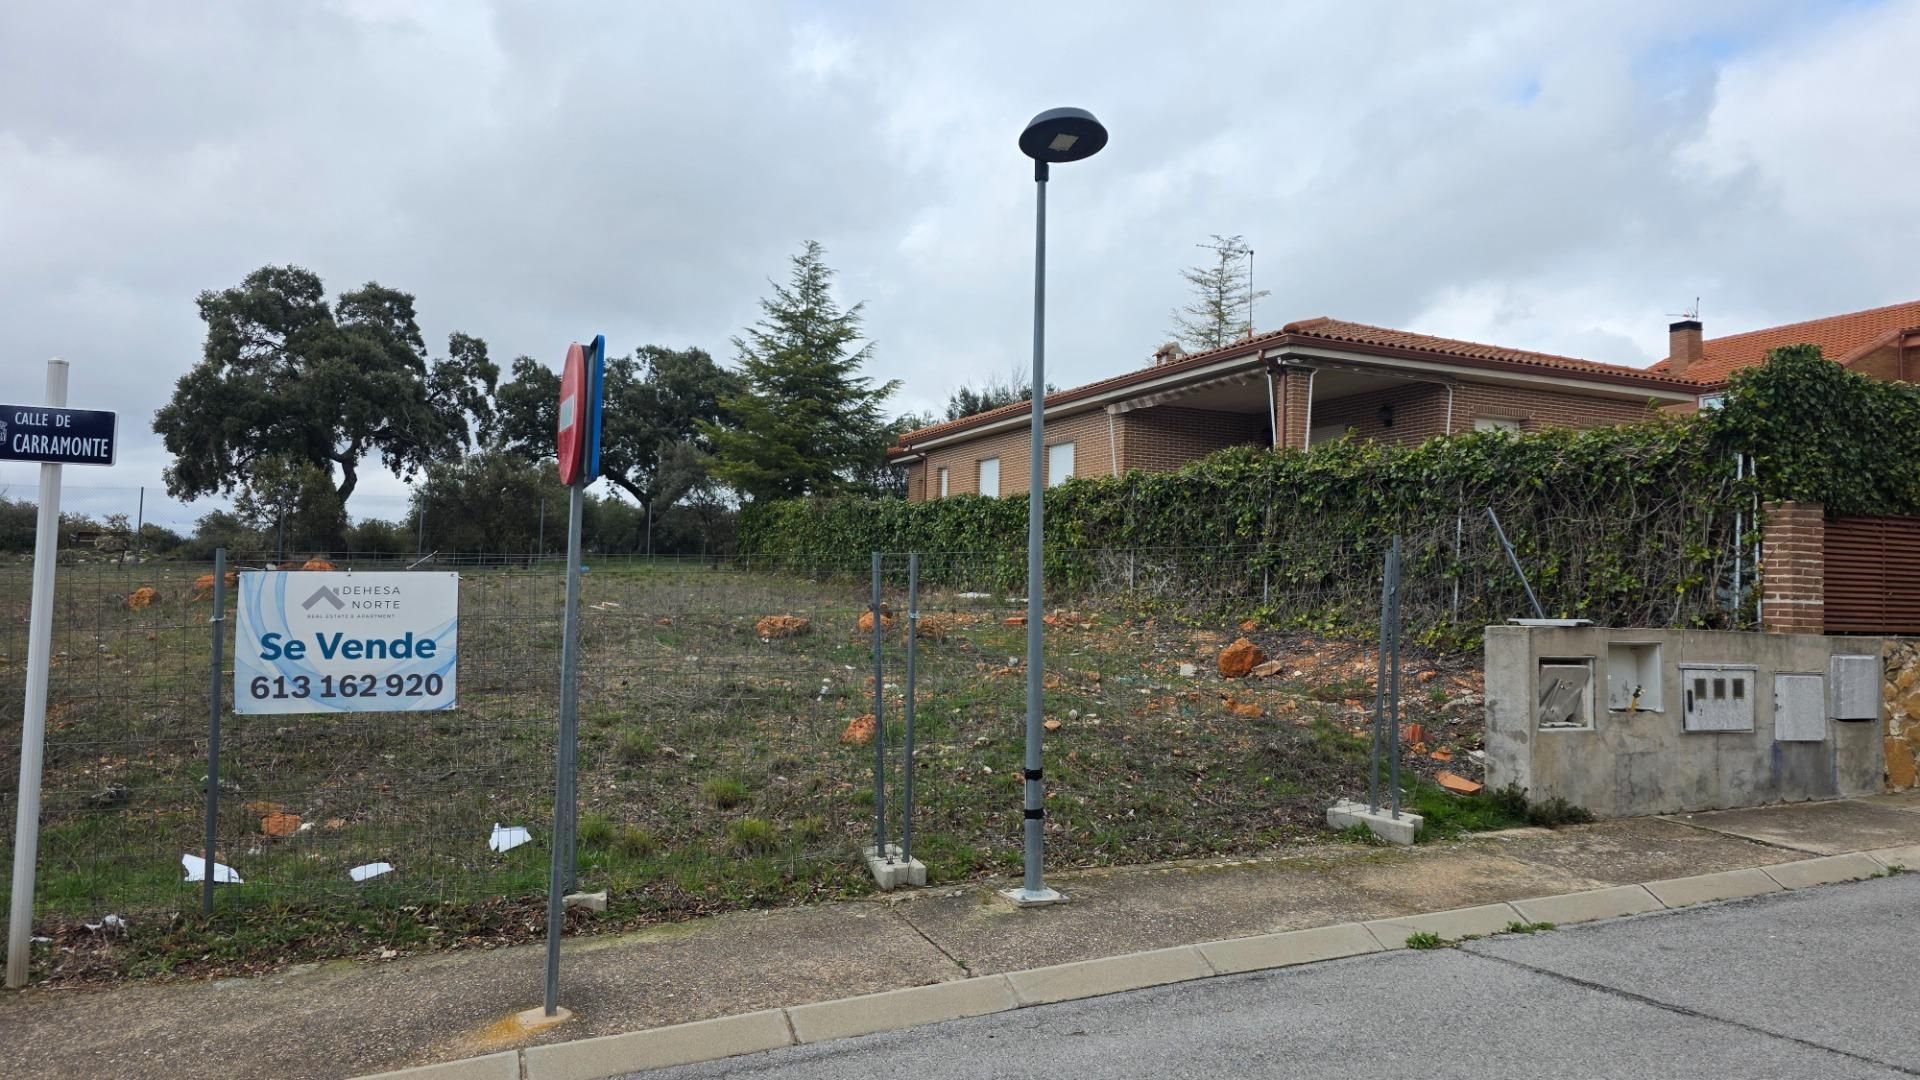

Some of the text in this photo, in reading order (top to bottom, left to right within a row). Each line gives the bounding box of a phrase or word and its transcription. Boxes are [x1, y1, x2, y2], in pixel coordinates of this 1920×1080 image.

[15, 412, 71, 427] CALLE DE
[13, 434, 108, 457] CARRAMONTE
[342, 586, 400, 595] DEHESA
[351, 600, 400, 609] NORTE
[260, 632, 437, 660] Se Vende
[251, 673, 444, 700] 613 162 920
